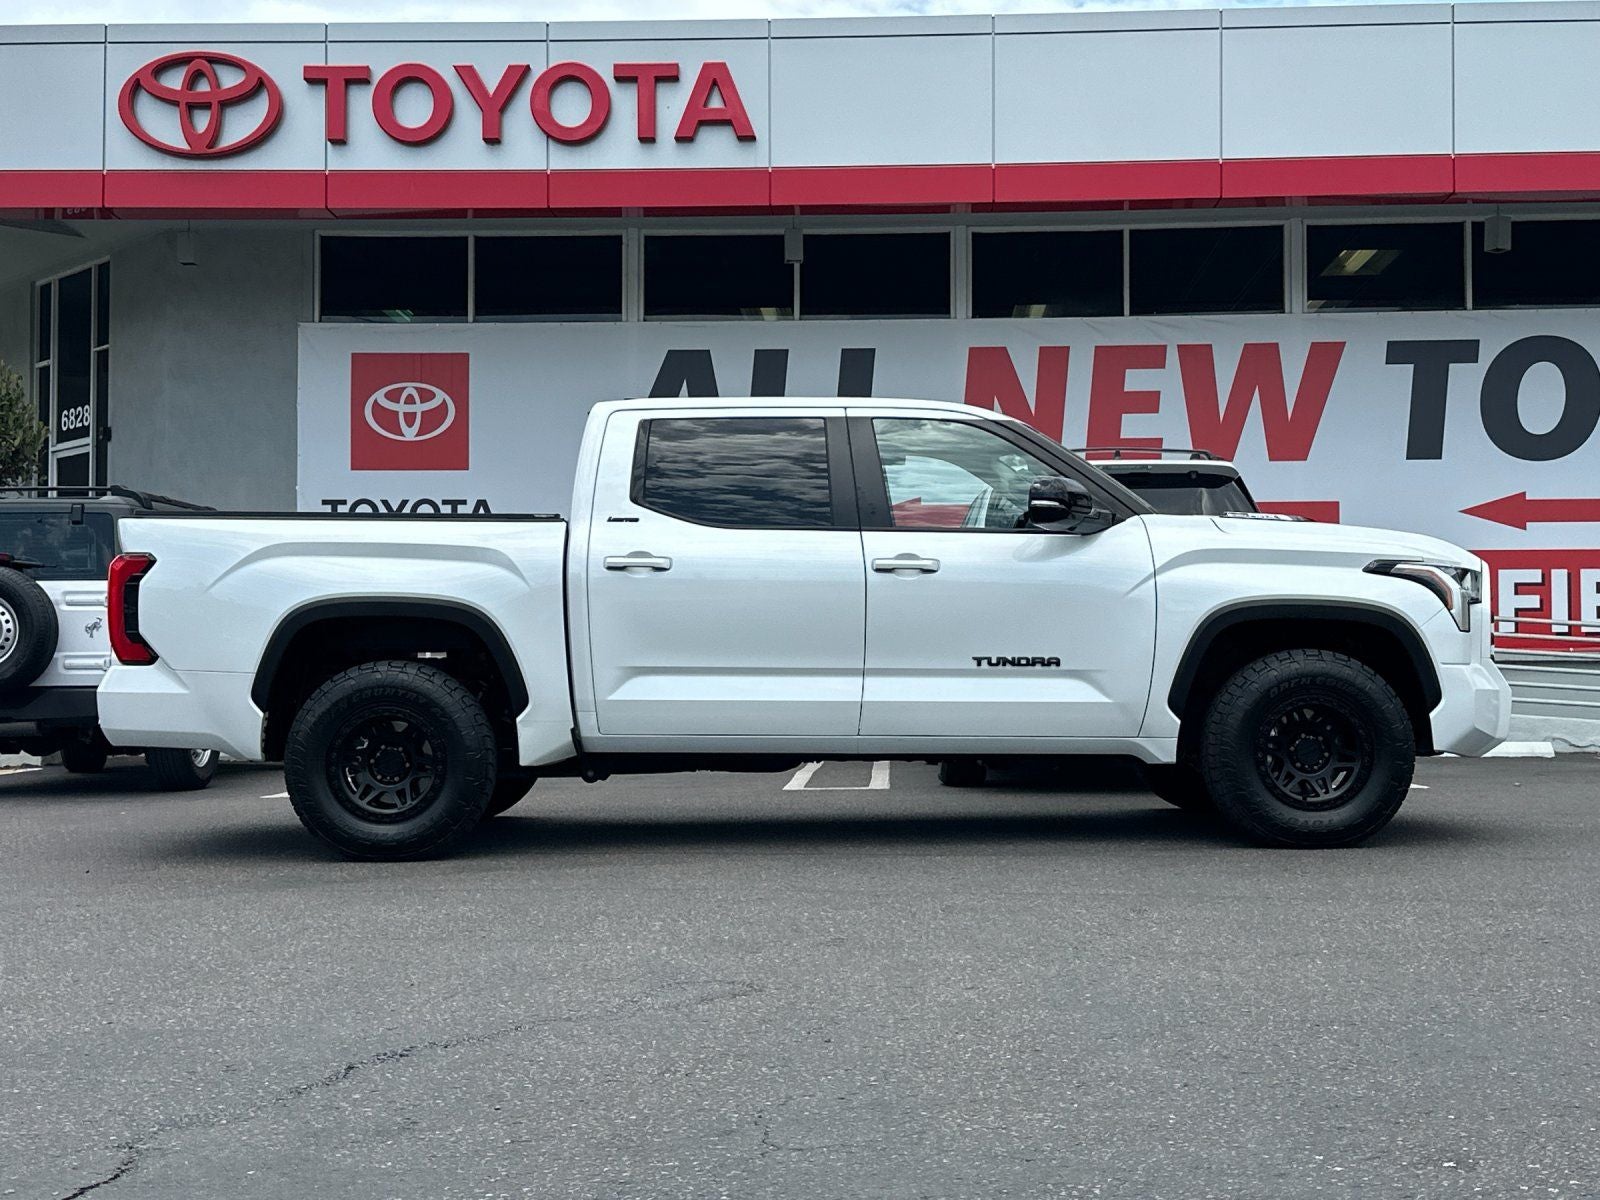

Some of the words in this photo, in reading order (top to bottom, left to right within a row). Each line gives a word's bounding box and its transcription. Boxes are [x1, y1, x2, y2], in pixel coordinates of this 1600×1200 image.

[304, 61, 757, 145] TOYOTA
[61, 404, 91, 432] 6828
[964, 340, 1347, 462] NEW
[972, 656, 1061, 667] TUNDRA
